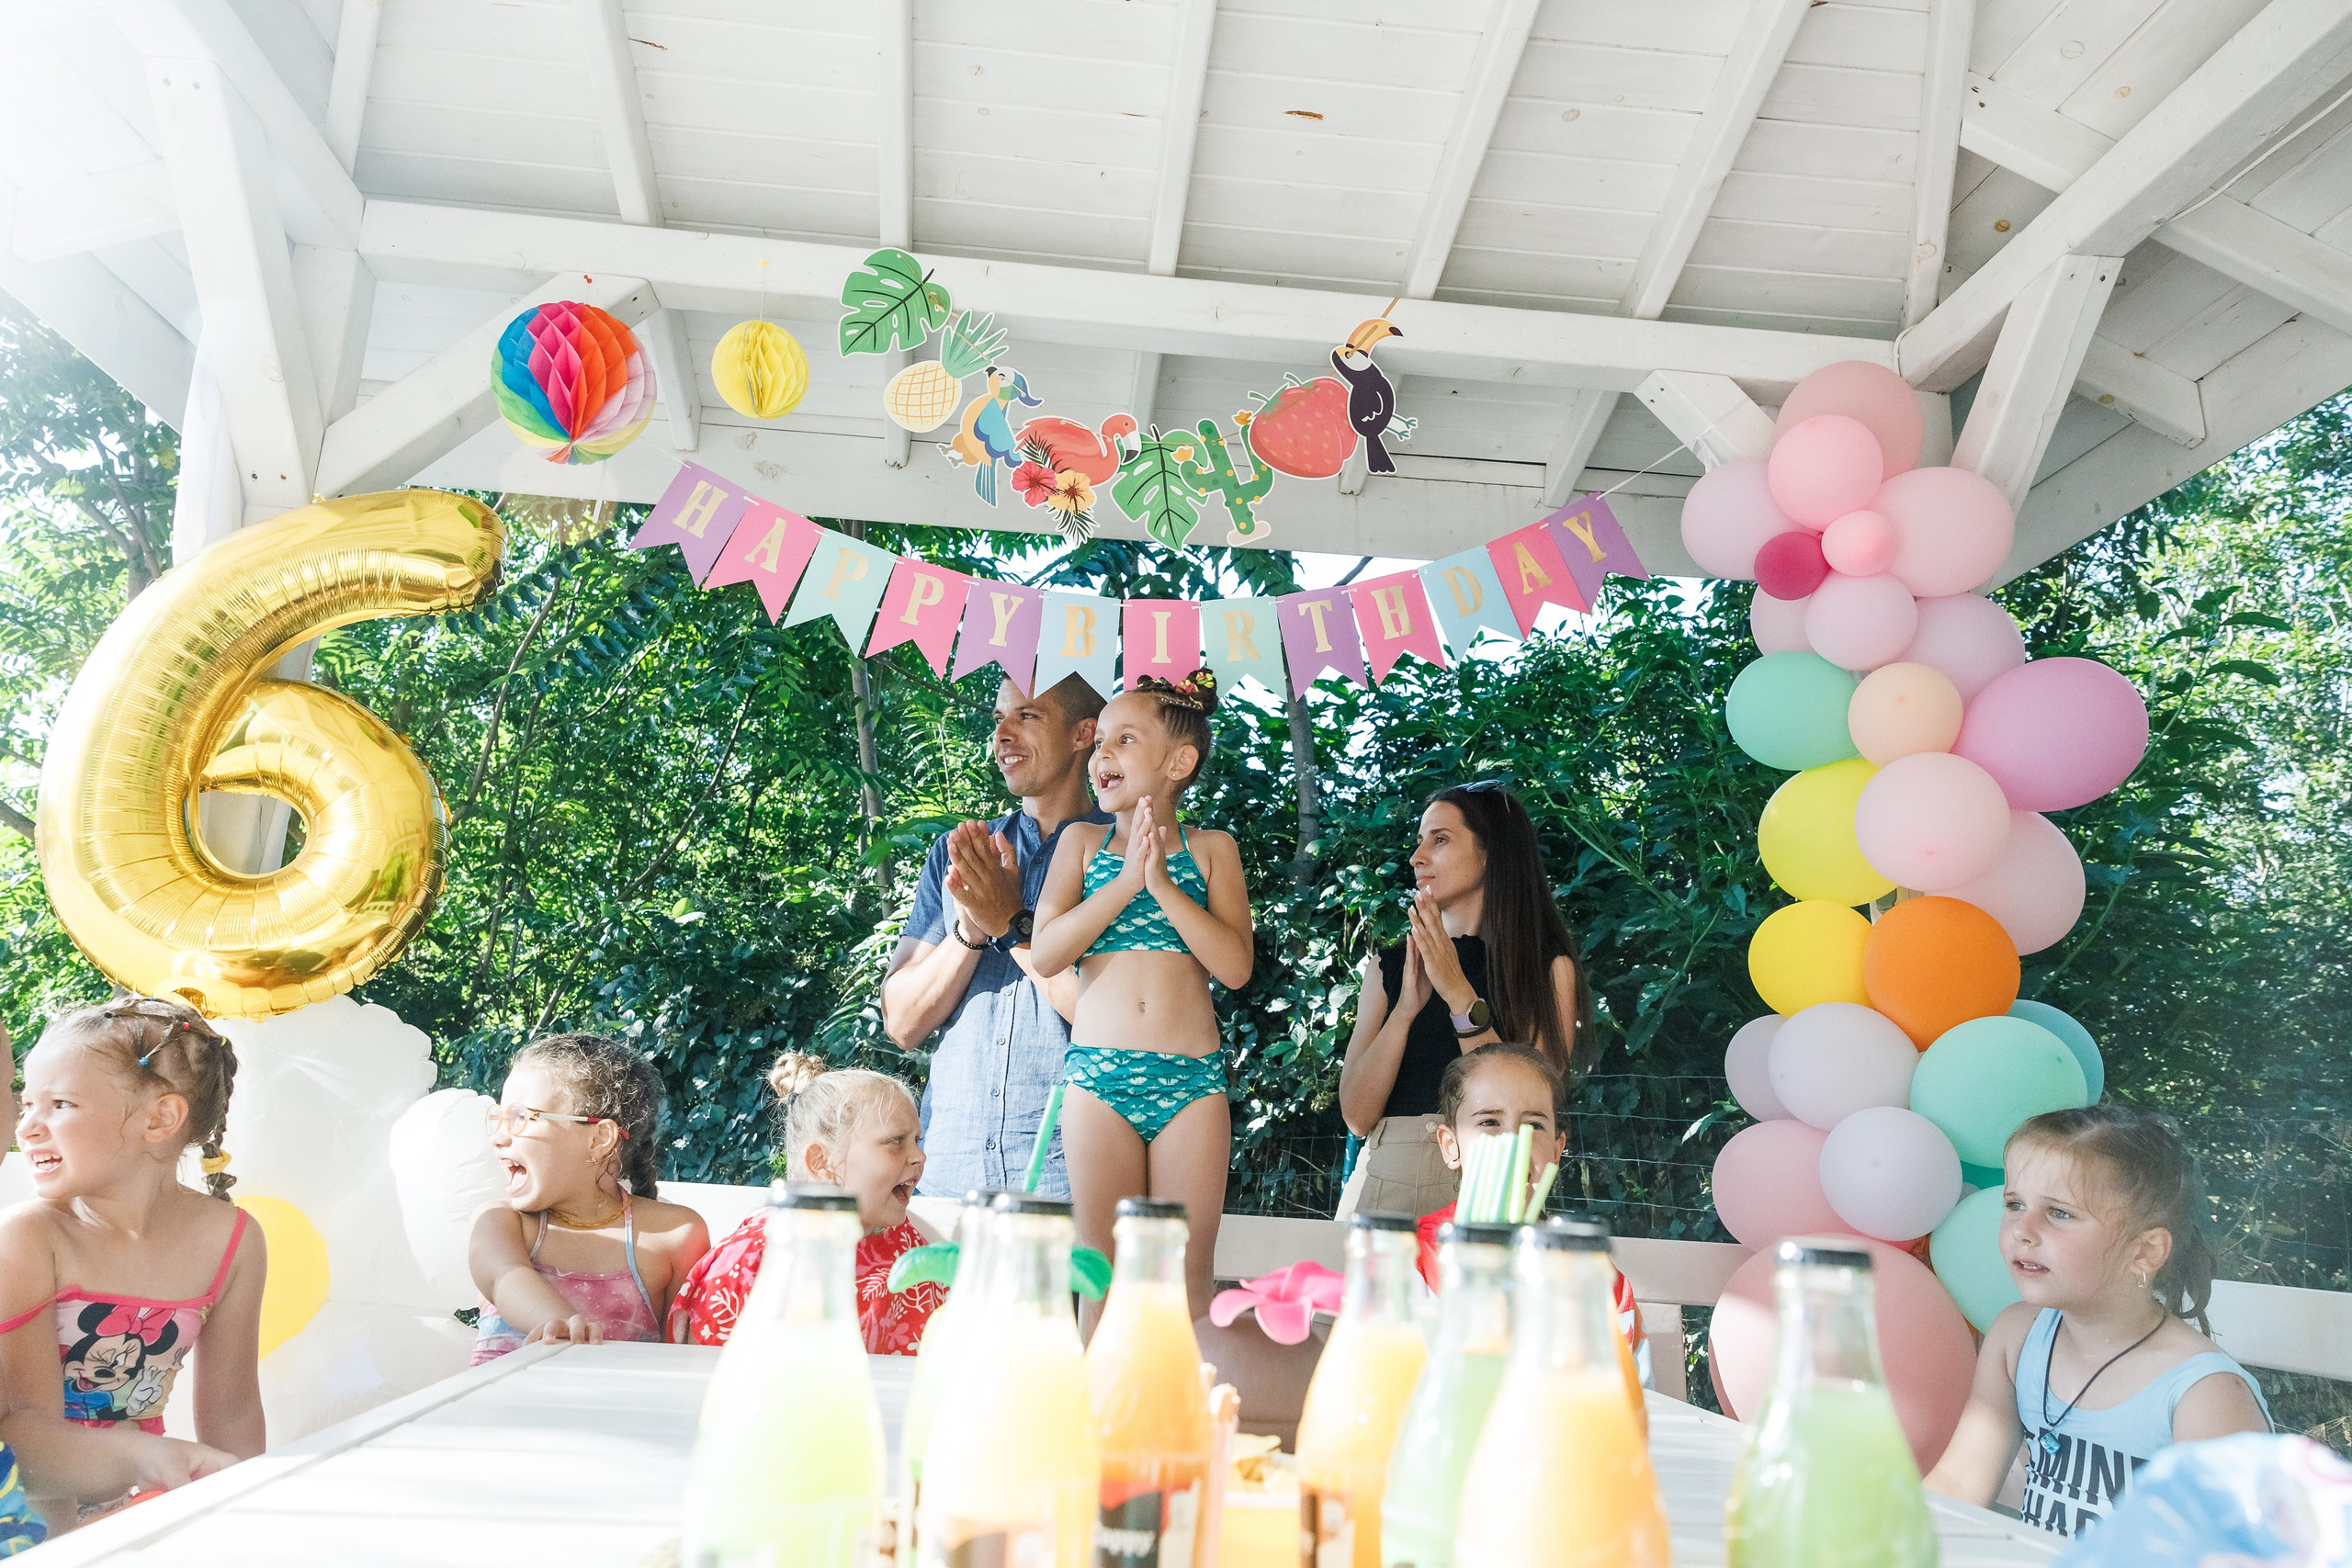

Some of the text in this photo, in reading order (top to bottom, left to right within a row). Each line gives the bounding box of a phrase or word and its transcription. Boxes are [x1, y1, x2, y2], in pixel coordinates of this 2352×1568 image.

[672, 480, 1607, 664] HAPPY BIRTHDAY
[35, 488, 507, 1021] 6
